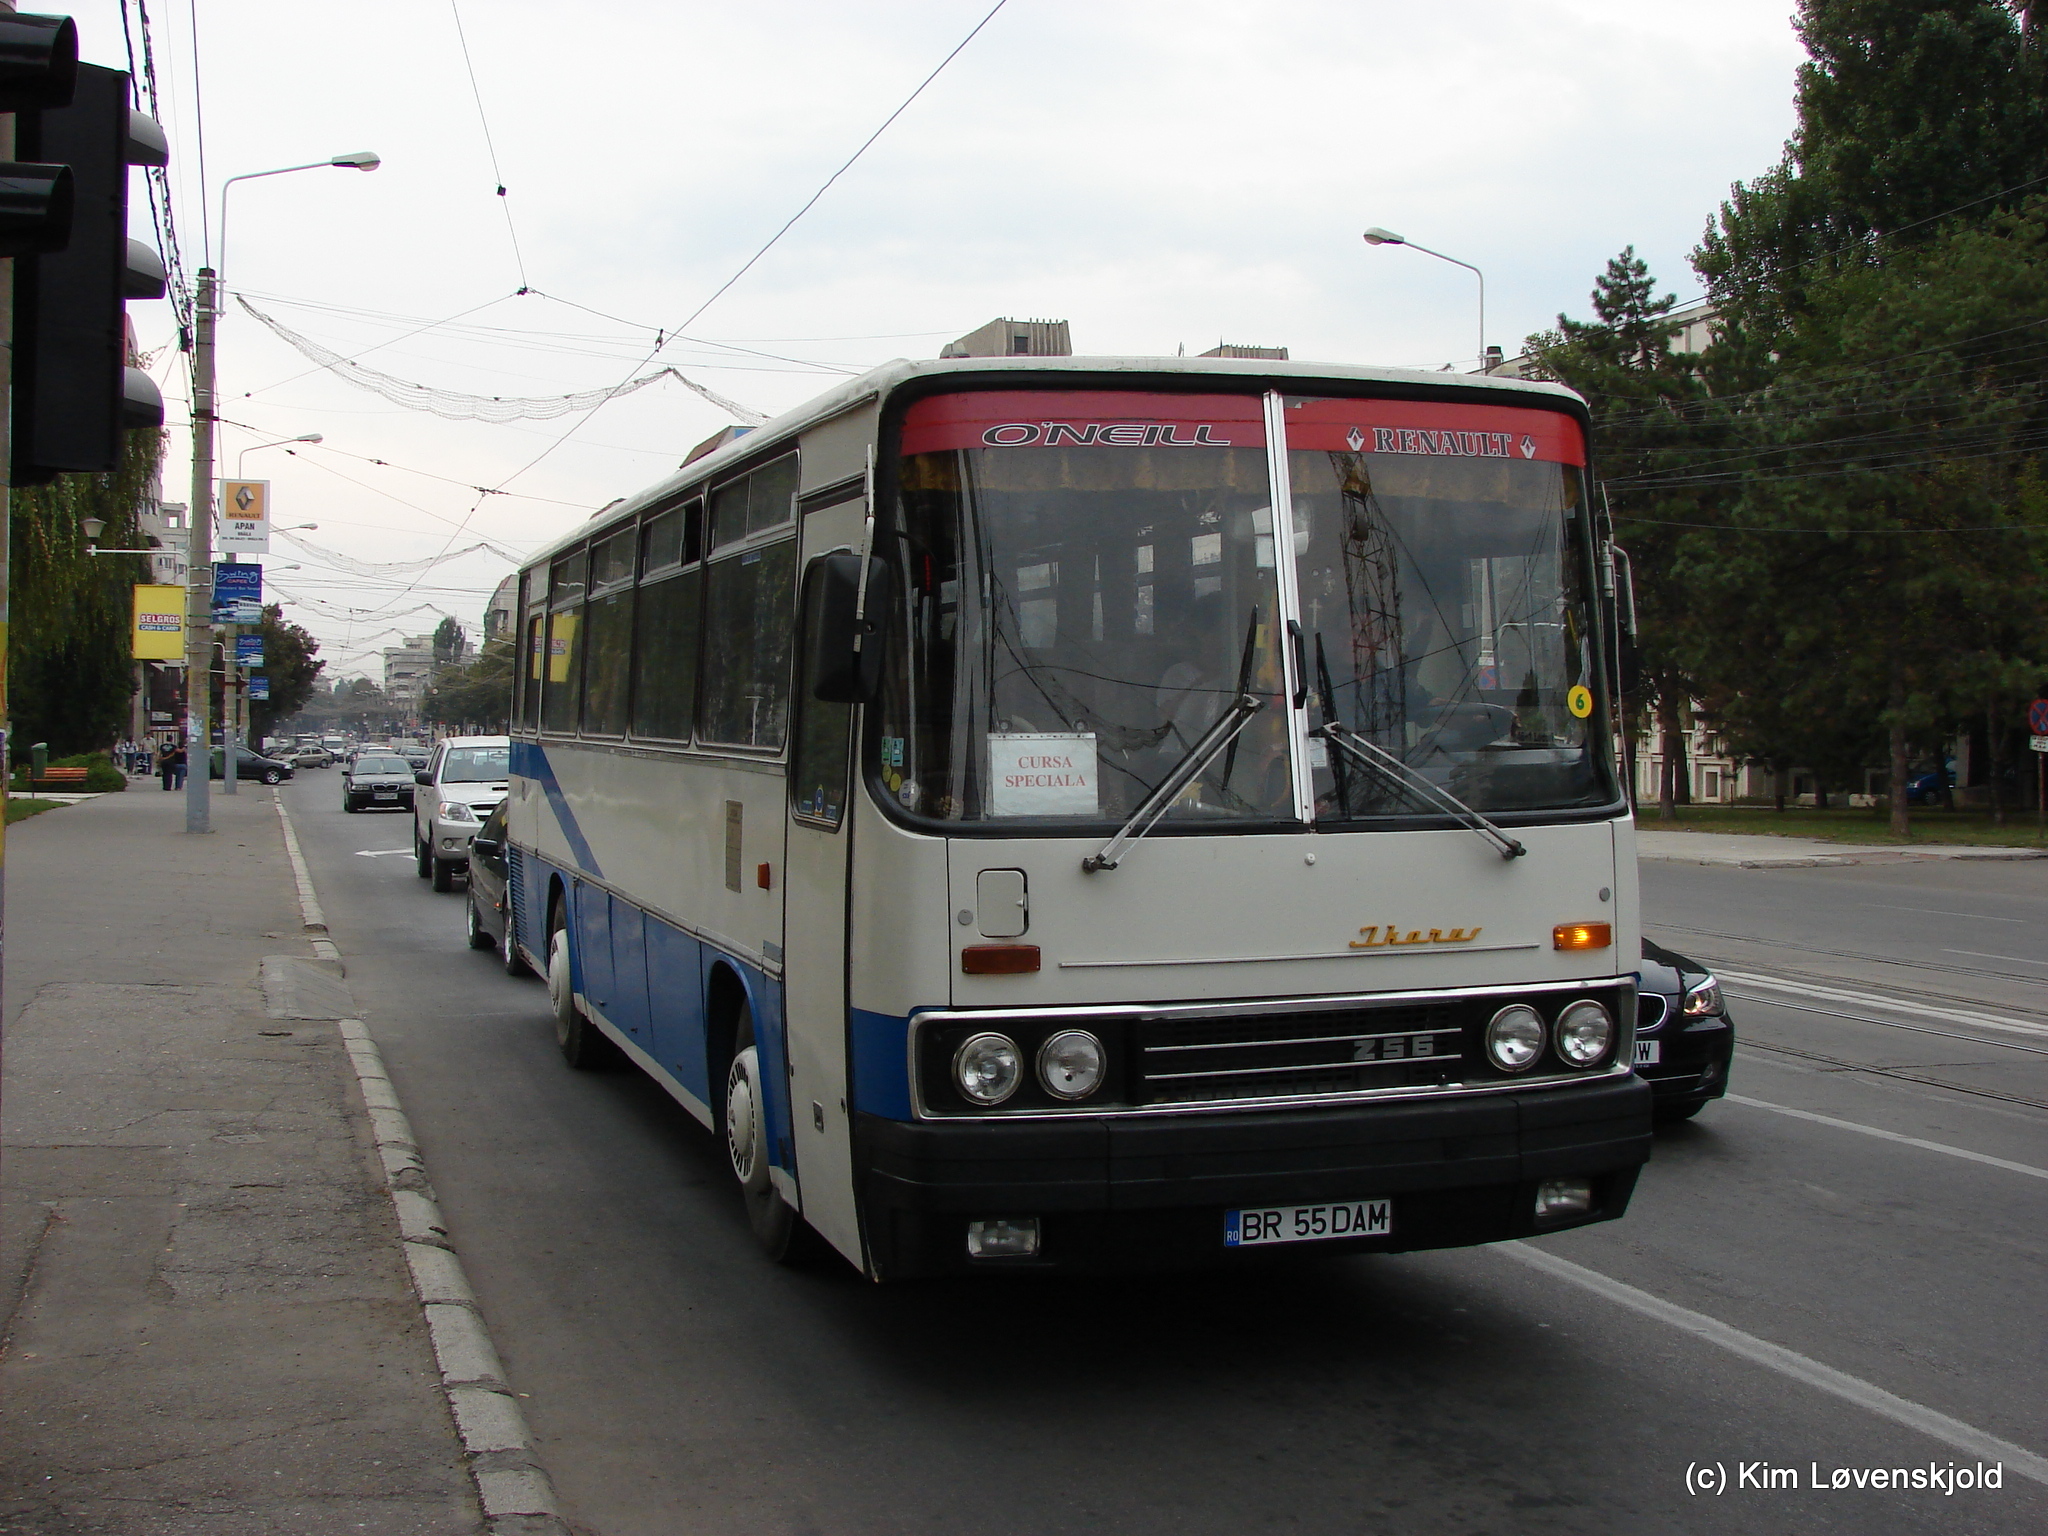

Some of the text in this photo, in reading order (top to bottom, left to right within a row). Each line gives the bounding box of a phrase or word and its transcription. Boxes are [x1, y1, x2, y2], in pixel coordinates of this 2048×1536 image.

[982, 421, 1231, 447] O'NEILL
[1372, 427, 1512, 458] RENAULT
[235, 522, 255, 530] APAN
[140, 615, 180, 624] SELGROS
[1575, 693, 1585, 711] 6
[1017, 756, 1073, 769] CURSA
[1004, 774, 1086, 789] SPECIALA
[1349, 924, 1483, 948] Ikarus
[1353, 1035, 1434, 1061] 256
[1242, 1211, 1283, 1241] BR
[1226, 1230, 1239, 1242] RO
